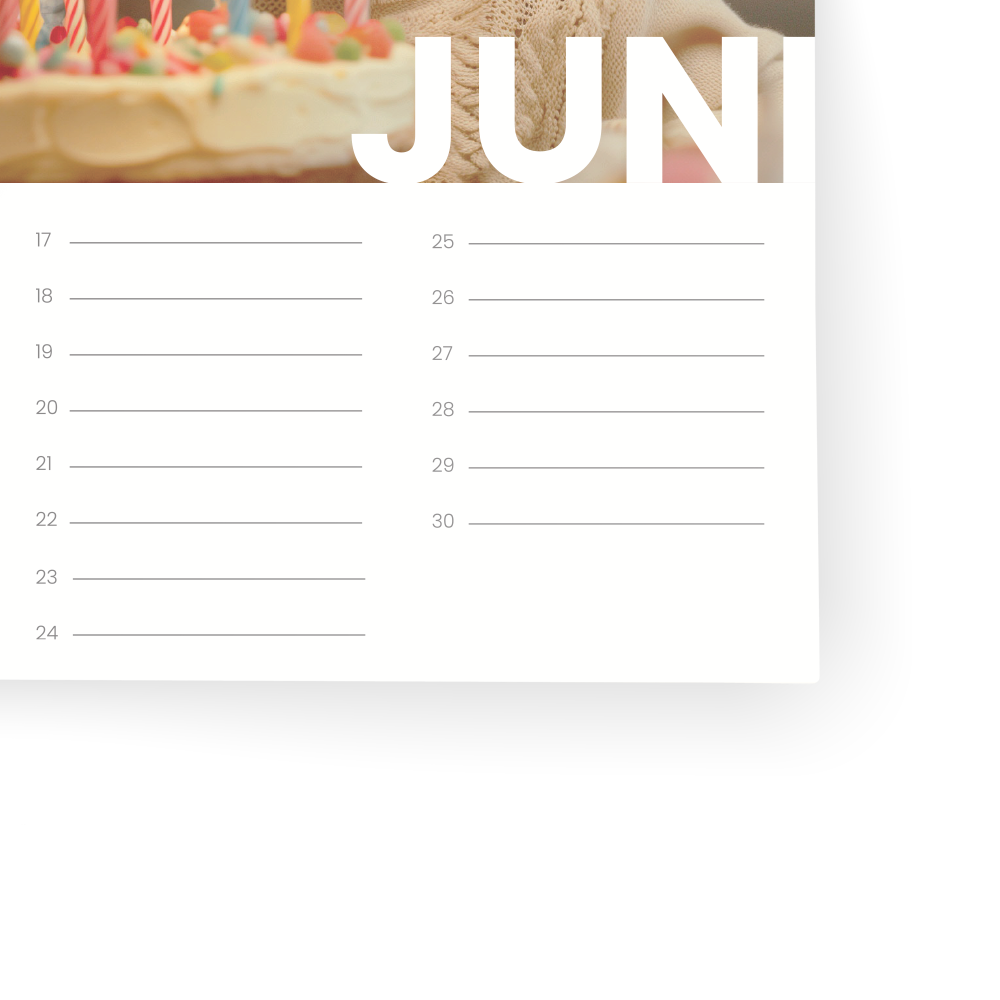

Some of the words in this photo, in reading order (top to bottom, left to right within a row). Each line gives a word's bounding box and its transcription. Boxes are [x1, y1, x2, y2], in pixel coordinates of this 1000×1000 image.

[352, 37, 815, 183] JUNI
[35, 231, 52, 248] 17
[431, 233, 455, 250] 25
[35, 287, 53, 304] 18
[431, 289, 455, 305] 26
[35, 343, 53, 360] 19
[431, 345, 453, 361] 27
[35, 399, 58, 415] 20
[431, 401, 455, 418] 28
[35, 455, 52, 471] 21
[431, 457, 455, 473] 29
[35, 511, 58, 527] 22
[431, 512, 455, 529] 30
[35, 568, 58, 585] 23
[35, 624, 59, 640] 24
